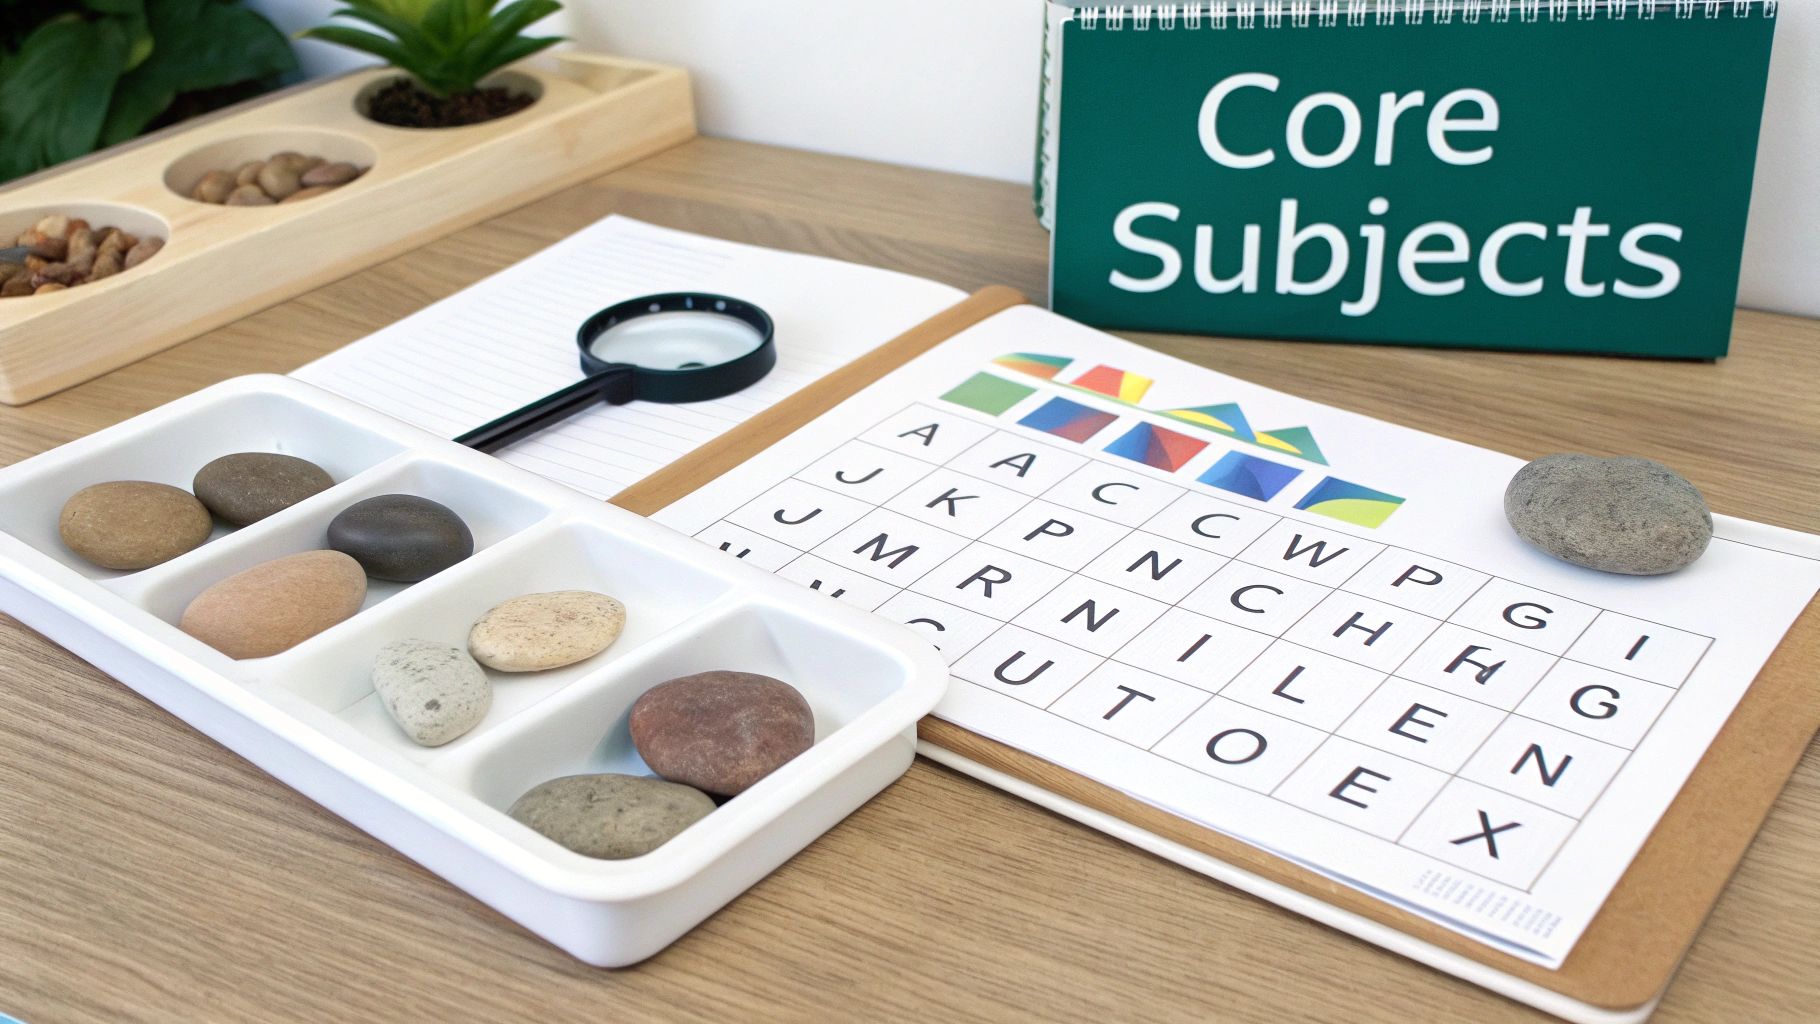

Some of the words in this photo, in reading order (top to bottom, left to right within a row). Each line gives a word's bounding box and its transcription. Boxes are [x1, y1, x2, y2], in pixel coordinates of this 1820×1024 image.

[1198, 72, 1499, 169] Core
[1109, 198, 1683, 317] Subjects
[774, 508, 824, 525] J
[853, 532, 920, 570] M
[956, 564, 1012, 599] R
[1060, 599, 1120, 633] N
[1177, 634, 1213, 662] I
[1272, 665, 1306, 704] L
[1388, 702, 1449, 744] E
[1510, 743, 1573, 787] N
[836, 467, 884, 485] J
[926, 487, 980, 517] K
[1023, 518, 1075, 541] P
[1126, 550, 1184, 581] N
[1230, 584, 1284, 614] C
[1333, 611, 1394, 647] H
[1570, 684, 1620, 720] G
[898, 423, 939, 447] A
[990, 453, 1037, 478] A
[1092, 482, 1140, 505] C
[1191, 513, 1240, 539] C
[1283, 533, 1350, 568] W
[1391, 564, 1444, 588] P
[1502, 602, 1555, 630] G
[1625, 635, 1650, 661] I
[994, 650, 1055, 686] U
[1102, 684, 1156, 720] T
[1206, 728, 1268, 765] O
[1329, 766, 1392, 809] E
[1451, 810, 1522, 859] X
